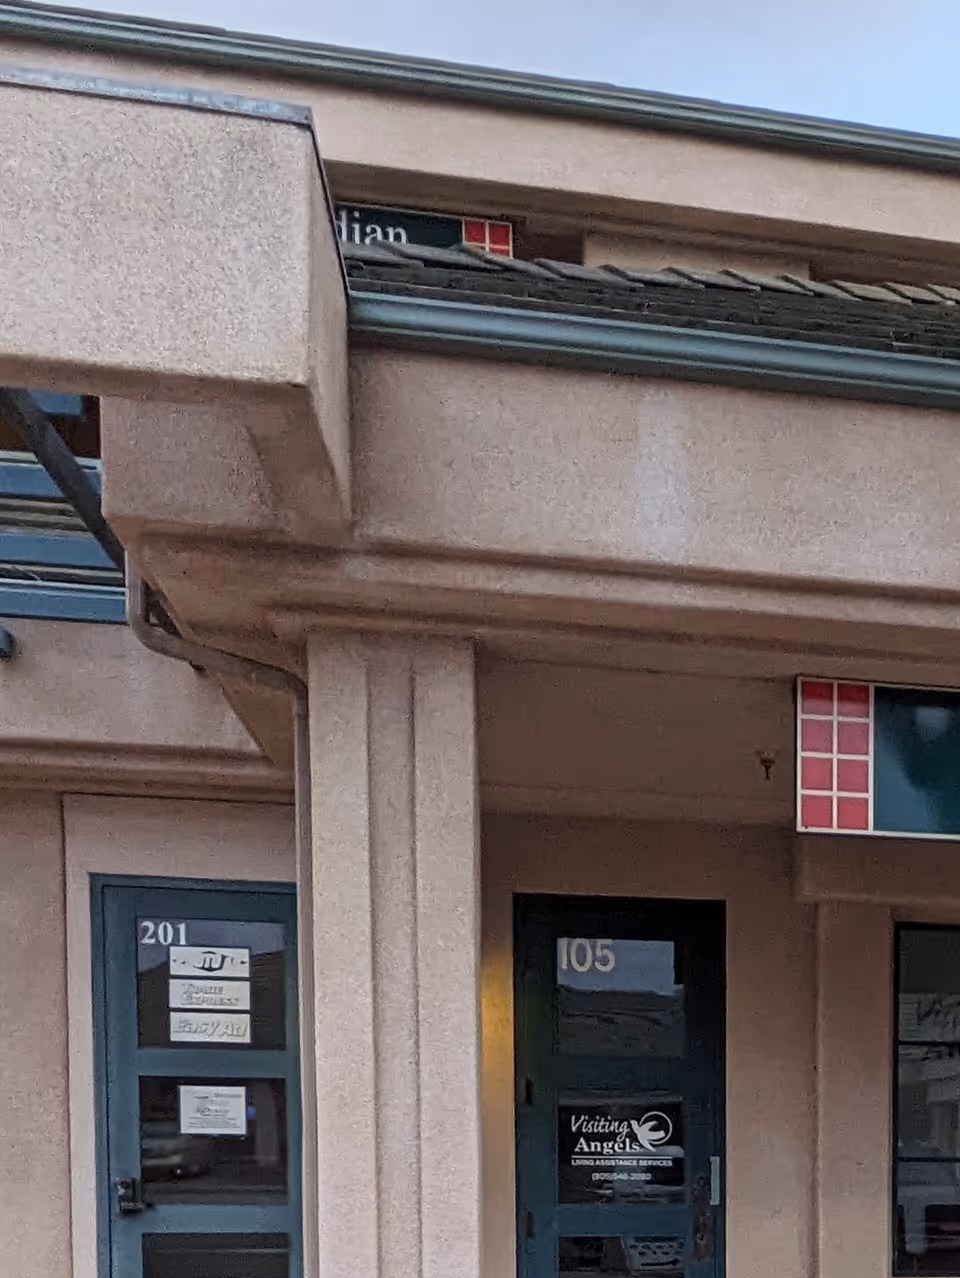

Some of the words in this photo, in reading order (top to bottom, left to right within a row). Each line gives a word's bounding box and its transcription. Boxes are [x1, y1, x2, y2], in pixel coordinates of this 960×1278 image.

[139, 920, 189, 946] 201
[558, 937, 616, 973] 105
[570, 1114, 631, 1142] Visiting
[573, 1136, 641, 1155] Angels
[571, 1158, 595, 1167] LIVING
[595, 1158, 638, 1167] ASSISTANCE
[638, 1159, 673, 1168] SERVICES
